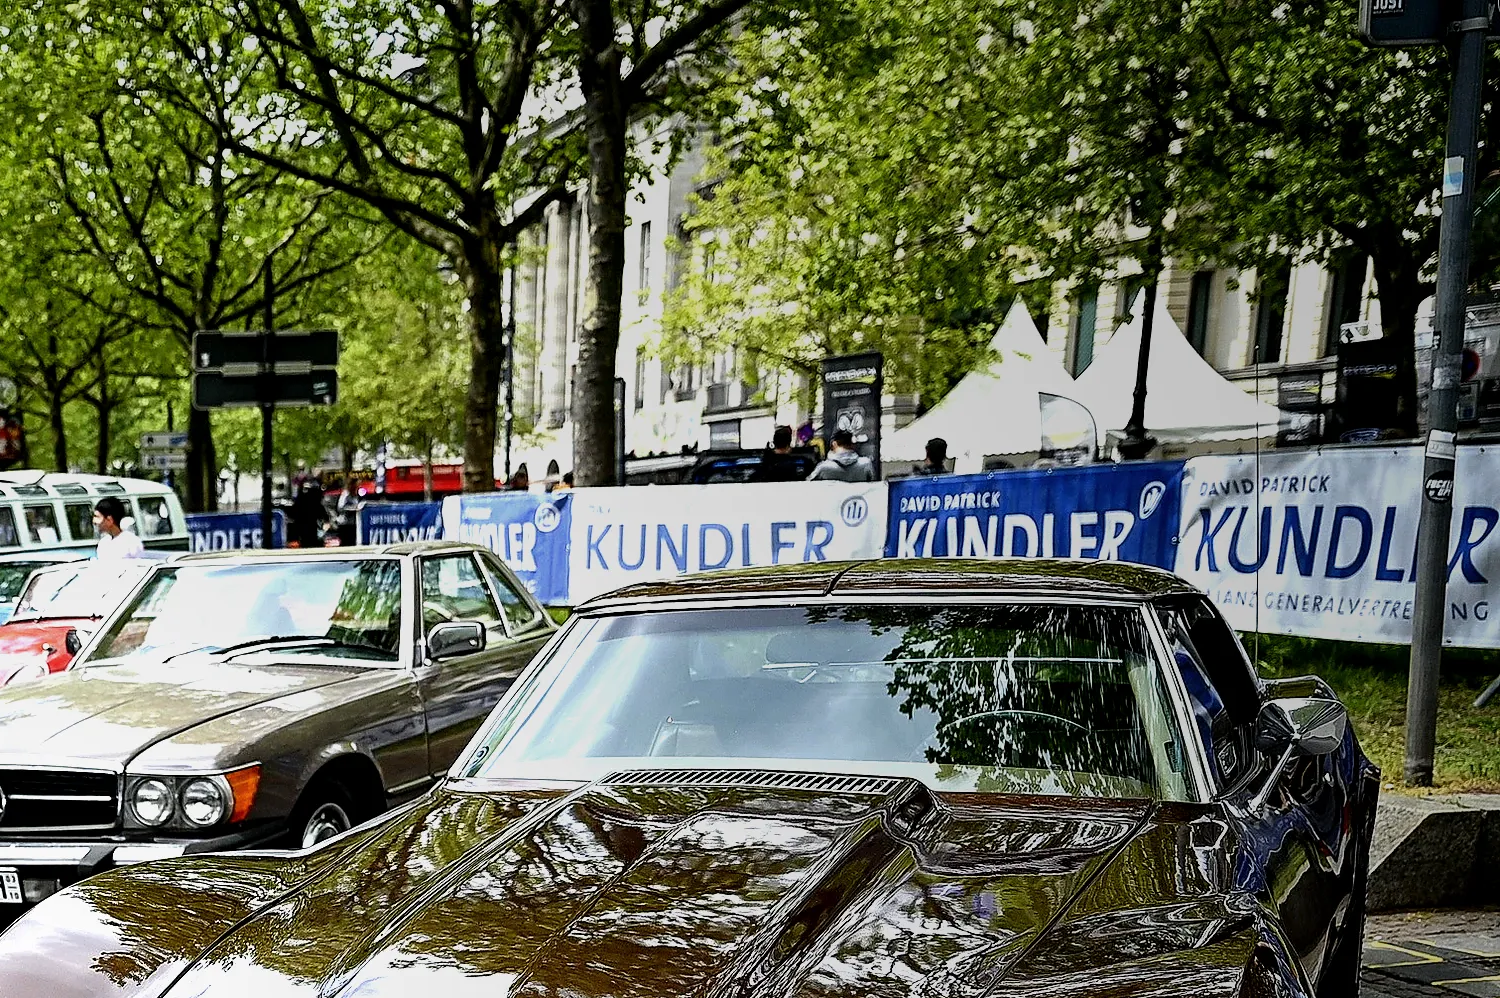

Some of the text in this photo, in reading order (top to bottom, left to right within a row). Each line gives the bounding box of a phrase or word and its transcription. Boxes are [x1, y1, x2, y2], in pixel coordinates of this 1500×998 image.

[1199, 475, 1331, 496] DAVID PATRICK
[900, 491, 1001, 512] DAVID PATRICK
[188, 528, 263, 553] NDLER
[1195, 505, 1499, 584] KUNDLR
[1264, 592, 1489, 622] GENERALVERTRENG
